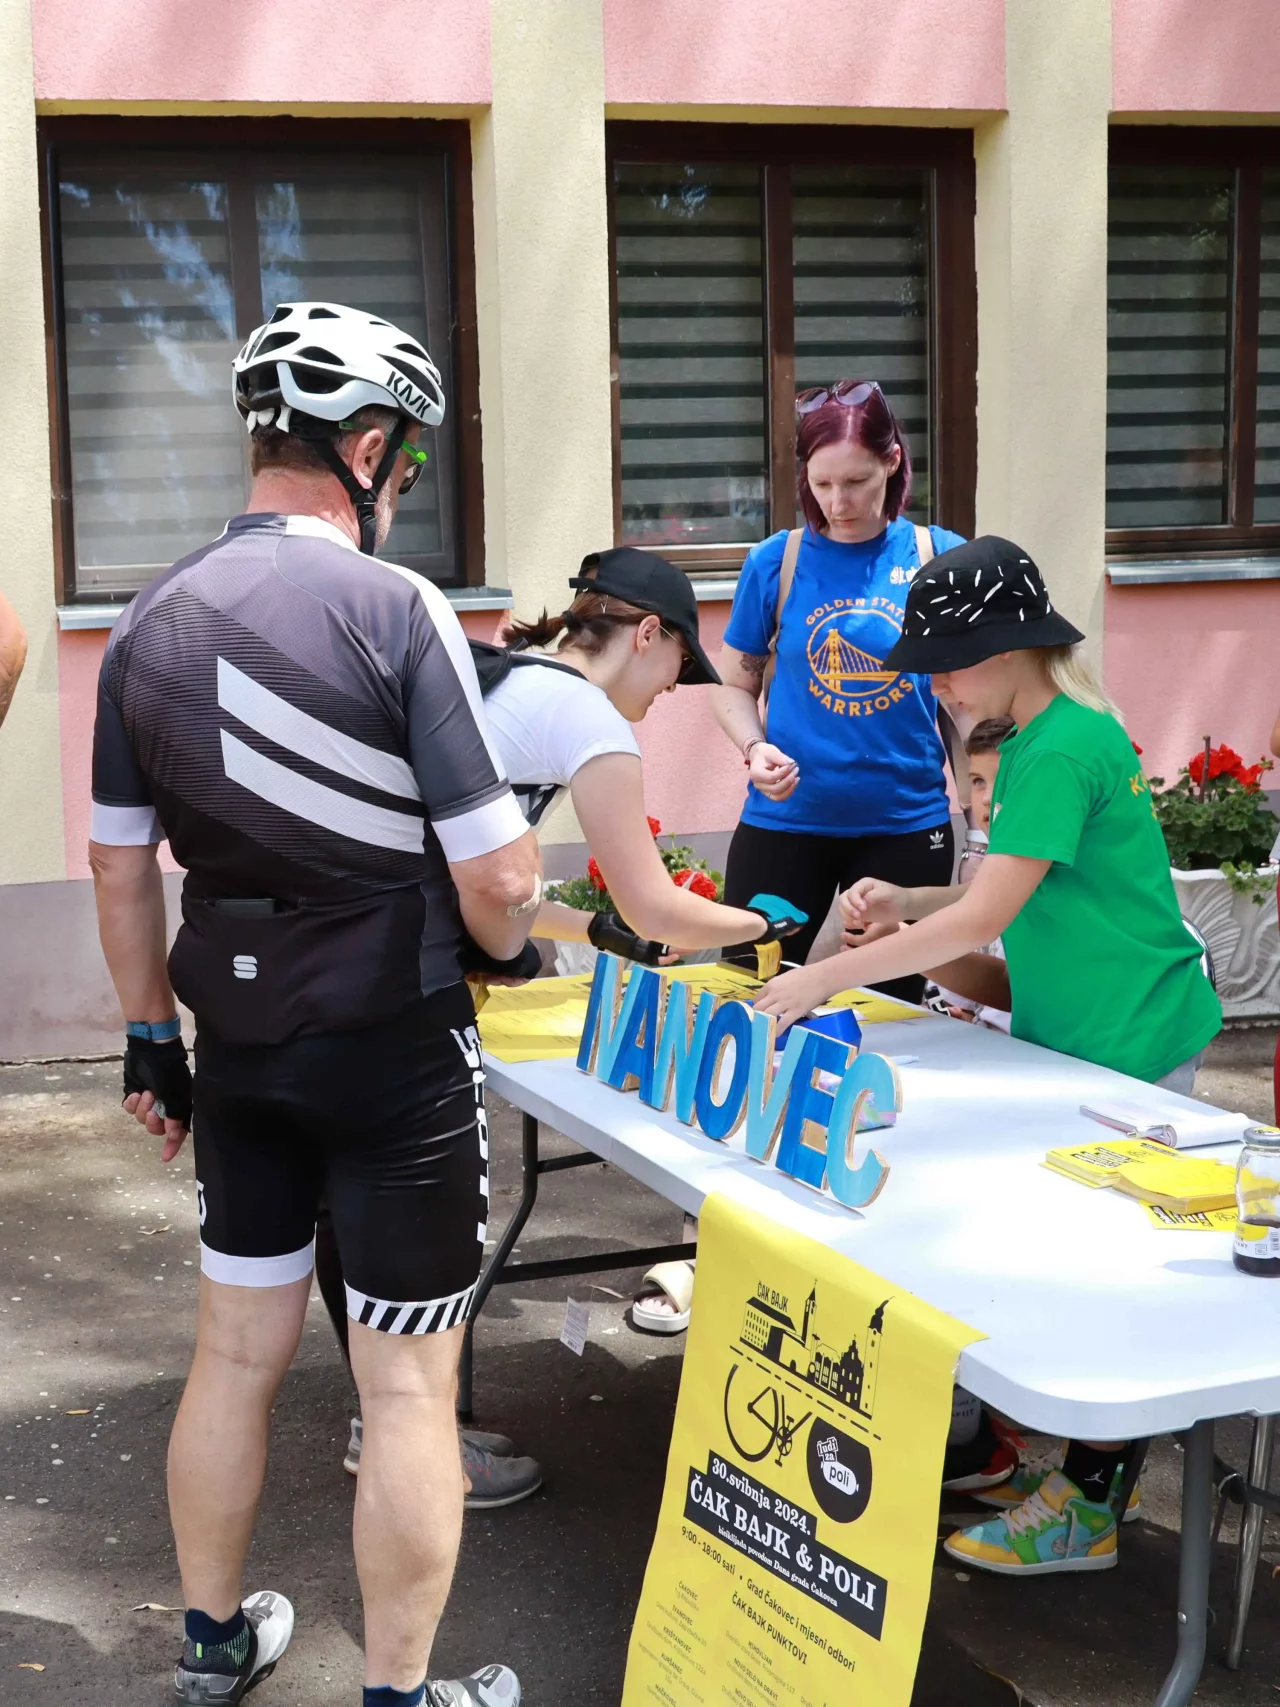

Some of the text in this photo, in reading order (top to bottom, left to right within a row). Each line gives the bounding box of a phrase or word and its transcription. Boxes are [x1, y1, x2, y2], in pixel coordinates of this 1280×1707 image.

[385, 370, 433, 420] KASK
[805, 597, 866, 626] GOLDEN
[808, 678, 915, 717] WARRIORS
[575, 950, 904, 1209] IVANOVEC
[770, 1289, 789, 1313] BAJK
[817, 1438, 837, 1455] ludi
[825, 1453, 835, 1461] za
[829, 1465, 850, 1487] poli
[774, 1498, 811, 1536] 2024.
[690, 1473, 877, 1612] ČAK BAJK & POLI
[747, 1546, 773, 1567] povodom
[773, 1559, 790, 1578] Dana
[790, 1572, 810, 1590] grada
[681, 1525, 697, 1545] 9:00
[702, 1541, 722, 1564] 18:00
[722, 1559, 736, 1576] sati
[746, 1578, 763, 1600] Grad
[764, 1590, 795, 1625] Čakovec
[800, 1622, 827, 1652] mjesni
[827, 1643, 856, 1673] odbori
[732, 1590, 746, 1614] ČAK
[747, 1606, 767, 1631] BAJK
[766, 1623, 808, 1666] PUNKTOVI
